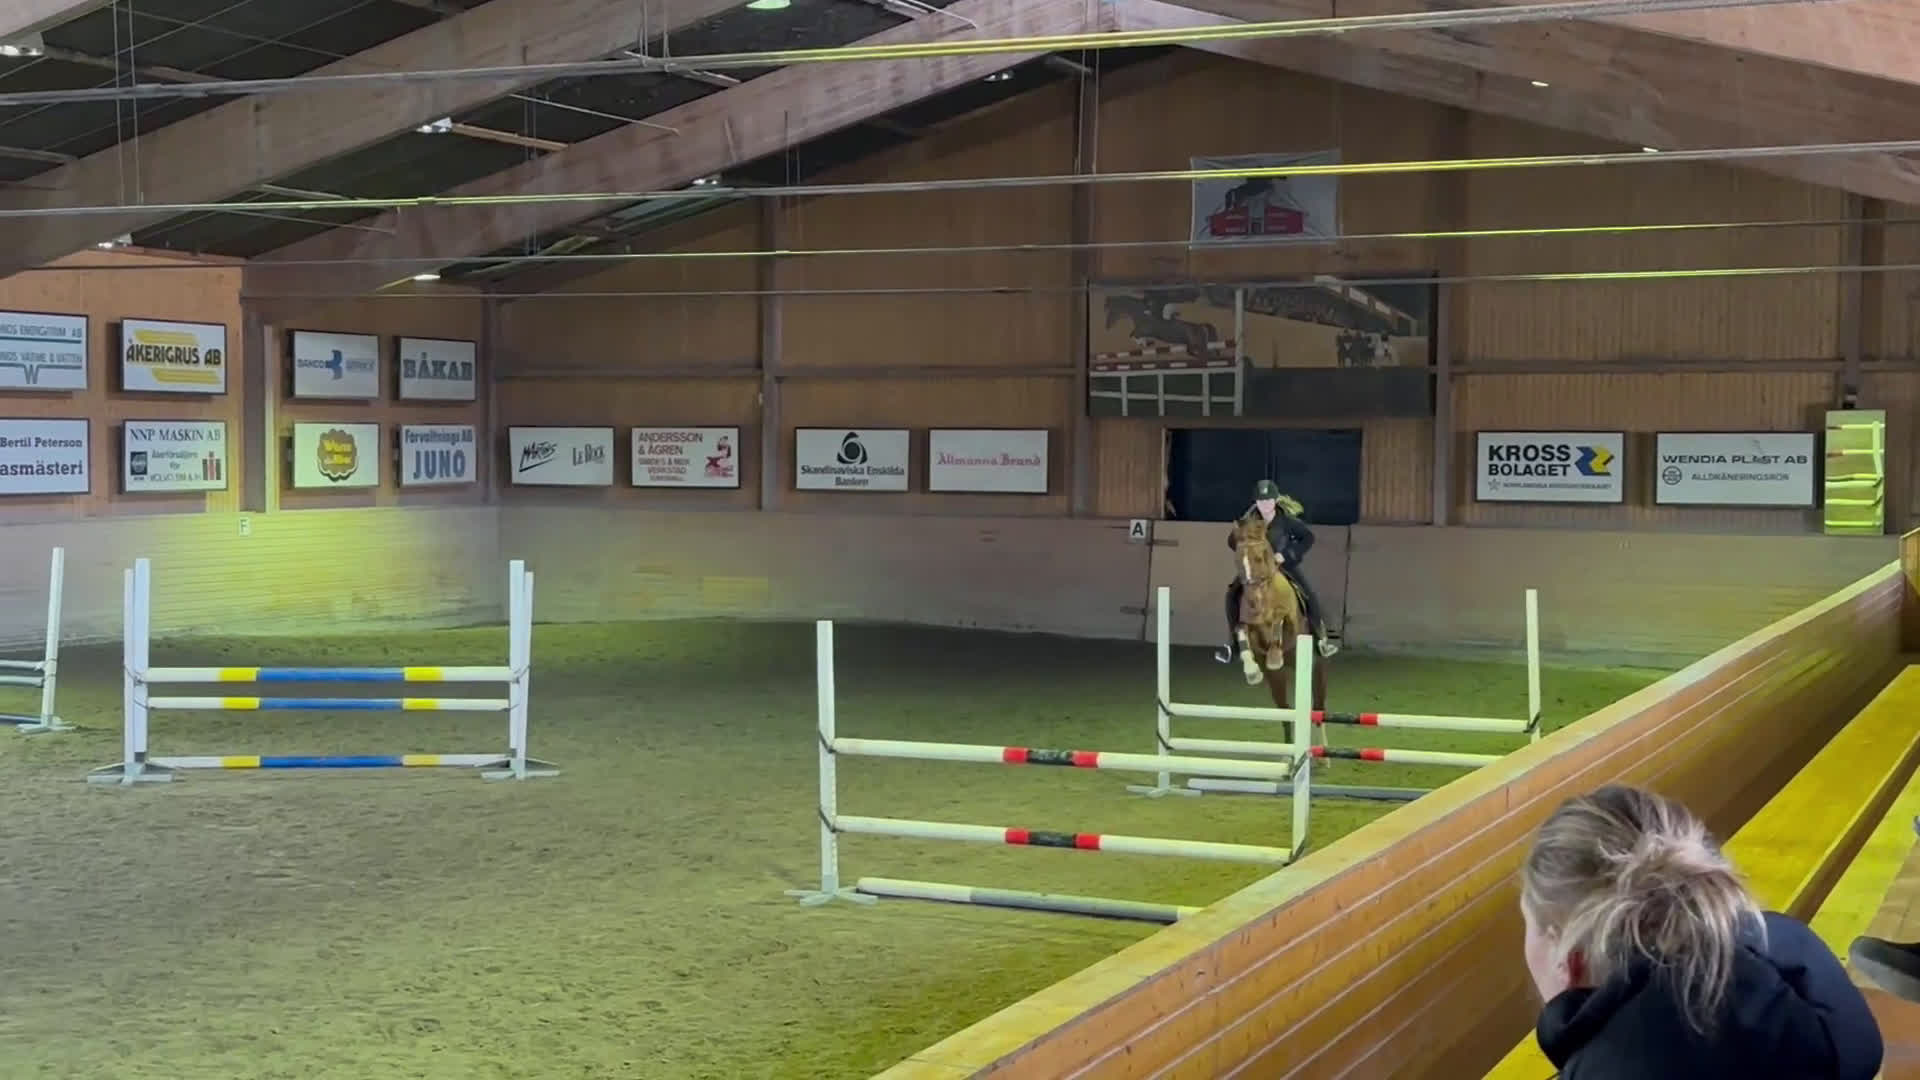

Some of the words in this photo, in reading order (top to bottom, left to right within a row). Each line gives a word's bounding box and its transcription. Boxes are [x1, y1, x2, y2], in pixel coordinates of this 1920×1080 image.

[126, 339, 200, 365] ÅKERIGRUS
[204, 348, 221, 365] AB
[130, 429, 155, 441] NNP
[159, 429, 204, 441] MASKIN
[208, 429, 221, 441] AB
[638, 432, 704, 443] ANDERSSON
[0, 437, 31, 448] Bertil
[34, 437, 83, 448] Peterson
[1488, 444, 1572, 462] KROSS
[1662, 455, 1728, 464] WENDIA
[1731, 455, 1781, 465] PLAST
[1784, 455, 1809, 465] AB
[413, 449, 466, 480] JUNO
[800, 464, 865, 475] Skandinaviska
[867, 464, 905, 475] Enskilda
[1488, 463, 1572, 477] BOLAGET
[240, 519, 248, 533] F
[1132, 521, 1144, 536] A
